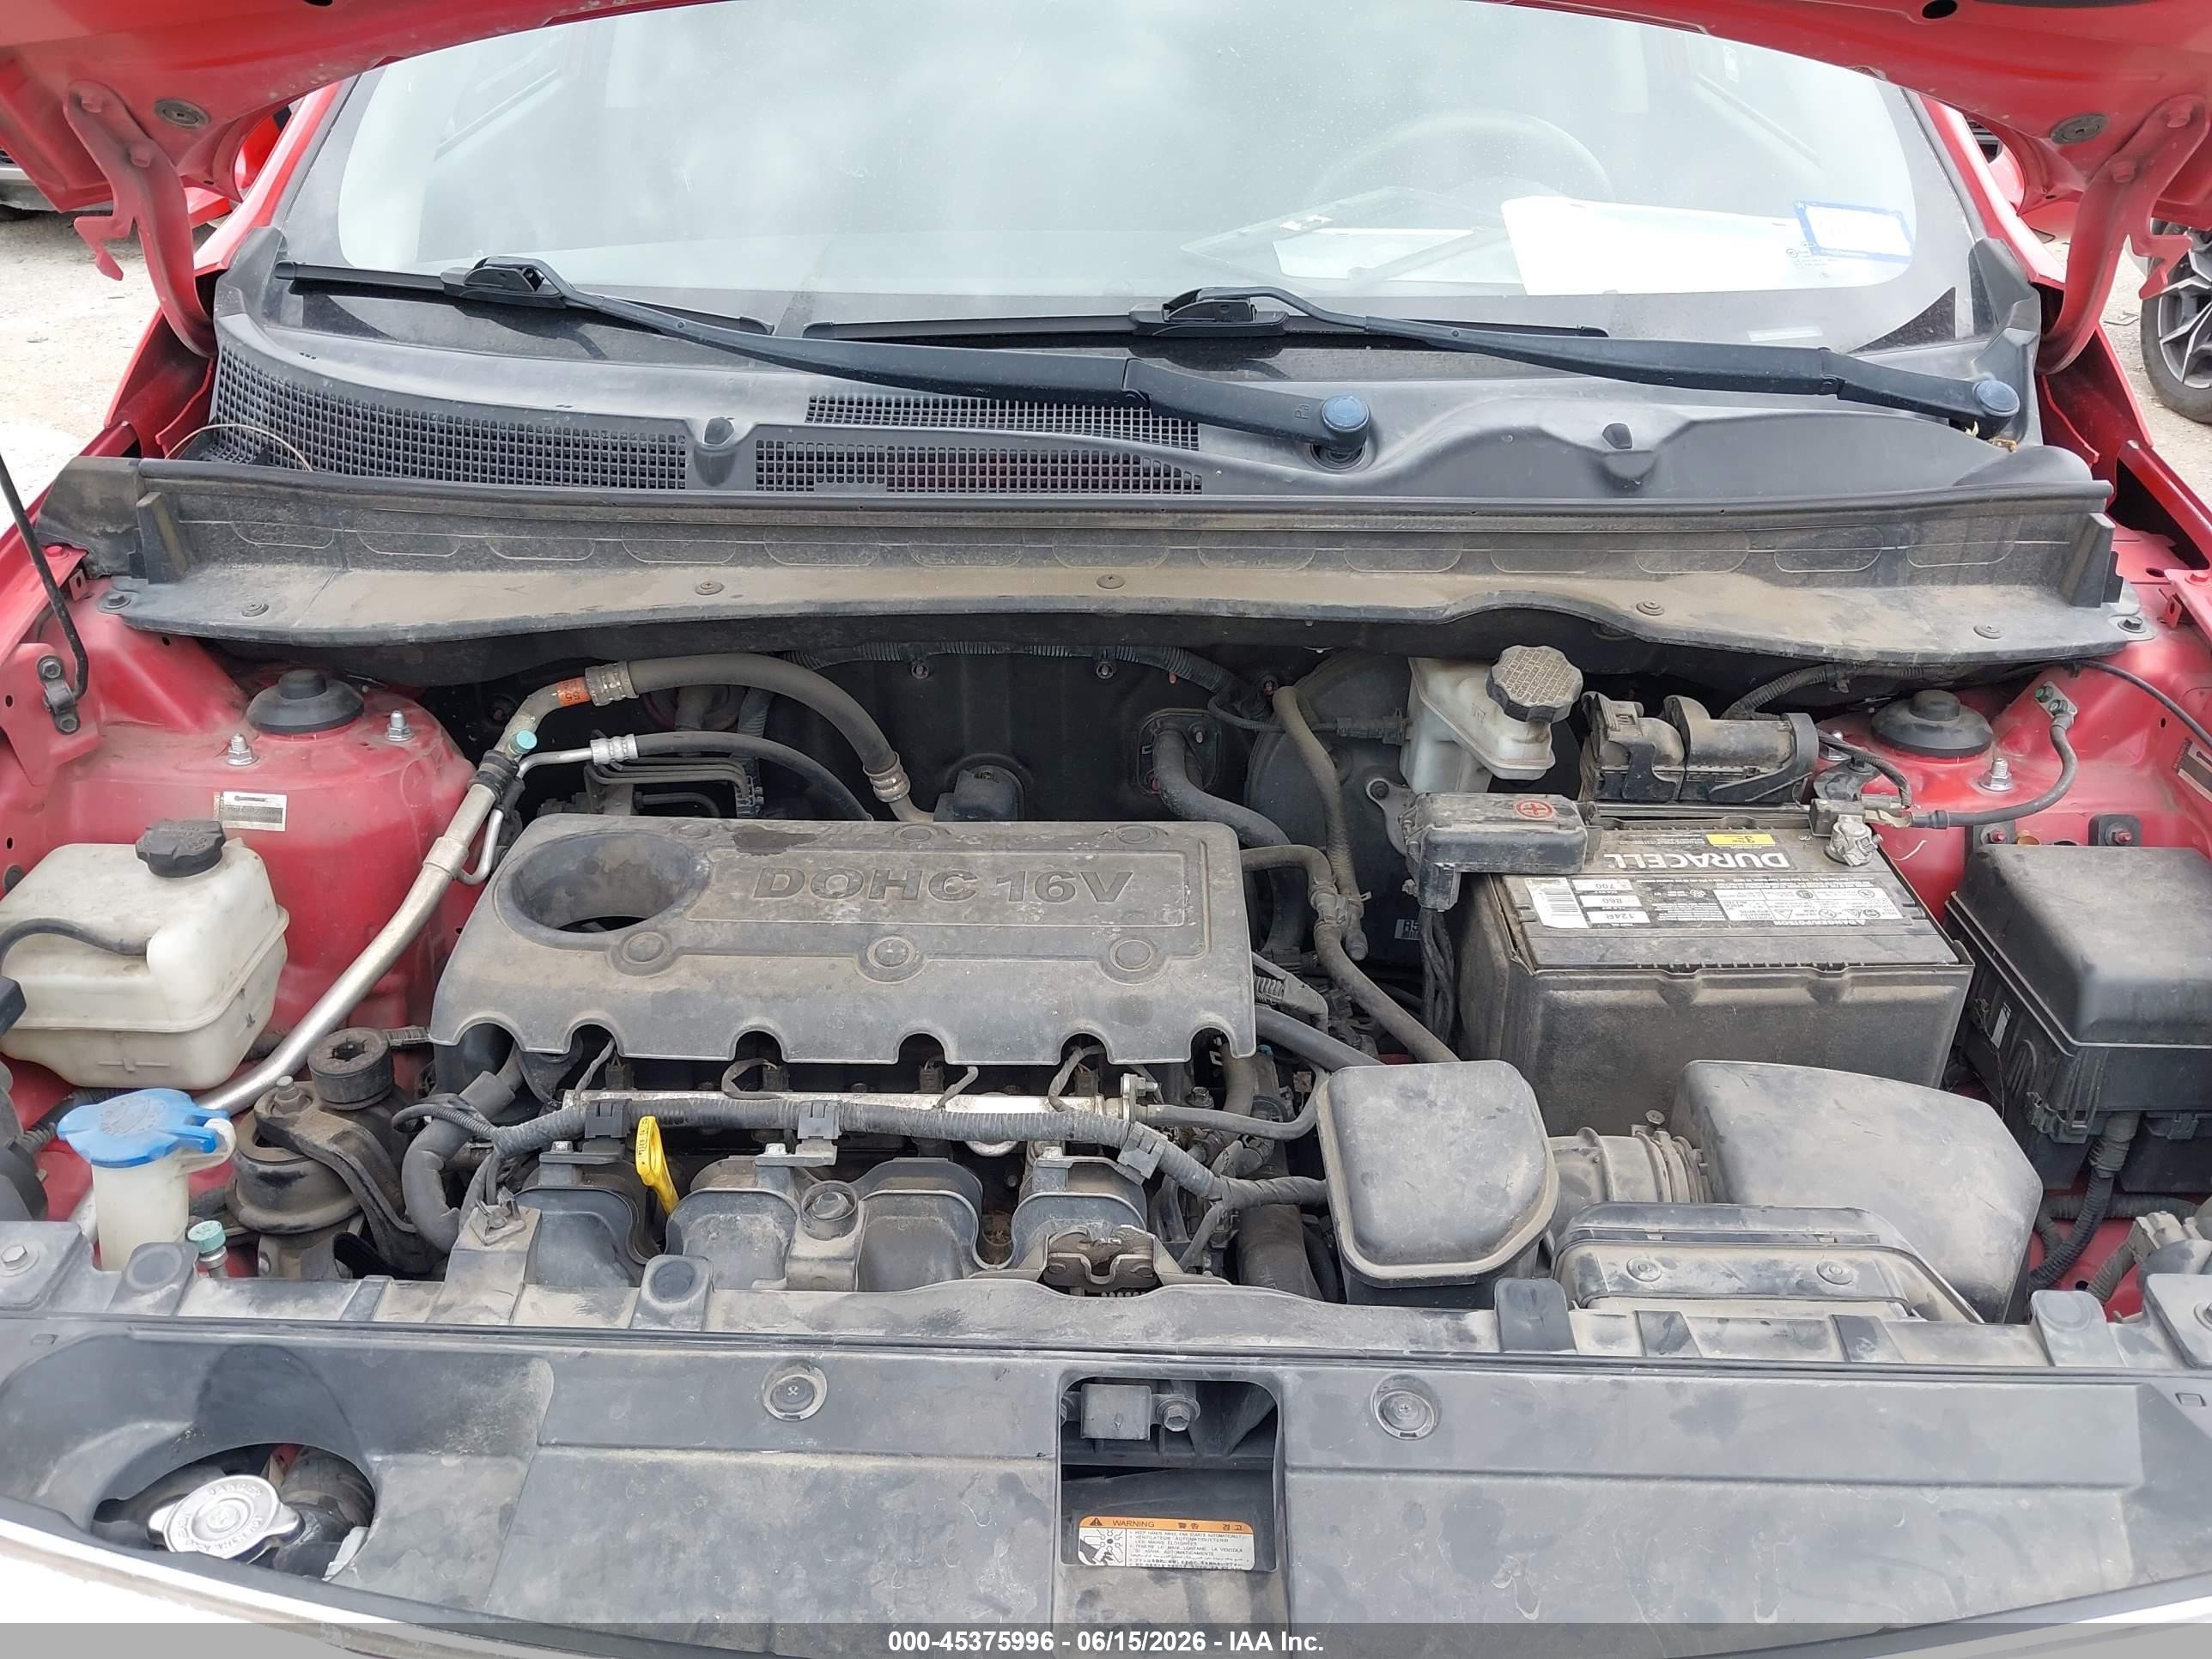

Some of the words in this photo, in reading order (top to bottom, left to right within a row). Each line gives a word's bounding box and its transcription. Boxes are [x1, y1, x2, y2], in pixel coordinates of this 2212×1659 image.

[1603, 853, 1791, 869] DURACELL
[752, 867, 979, 901] DOHC
[995, 870, 1133, 903] 16V
[1112, 1520, 1155, 1528] WARNING
